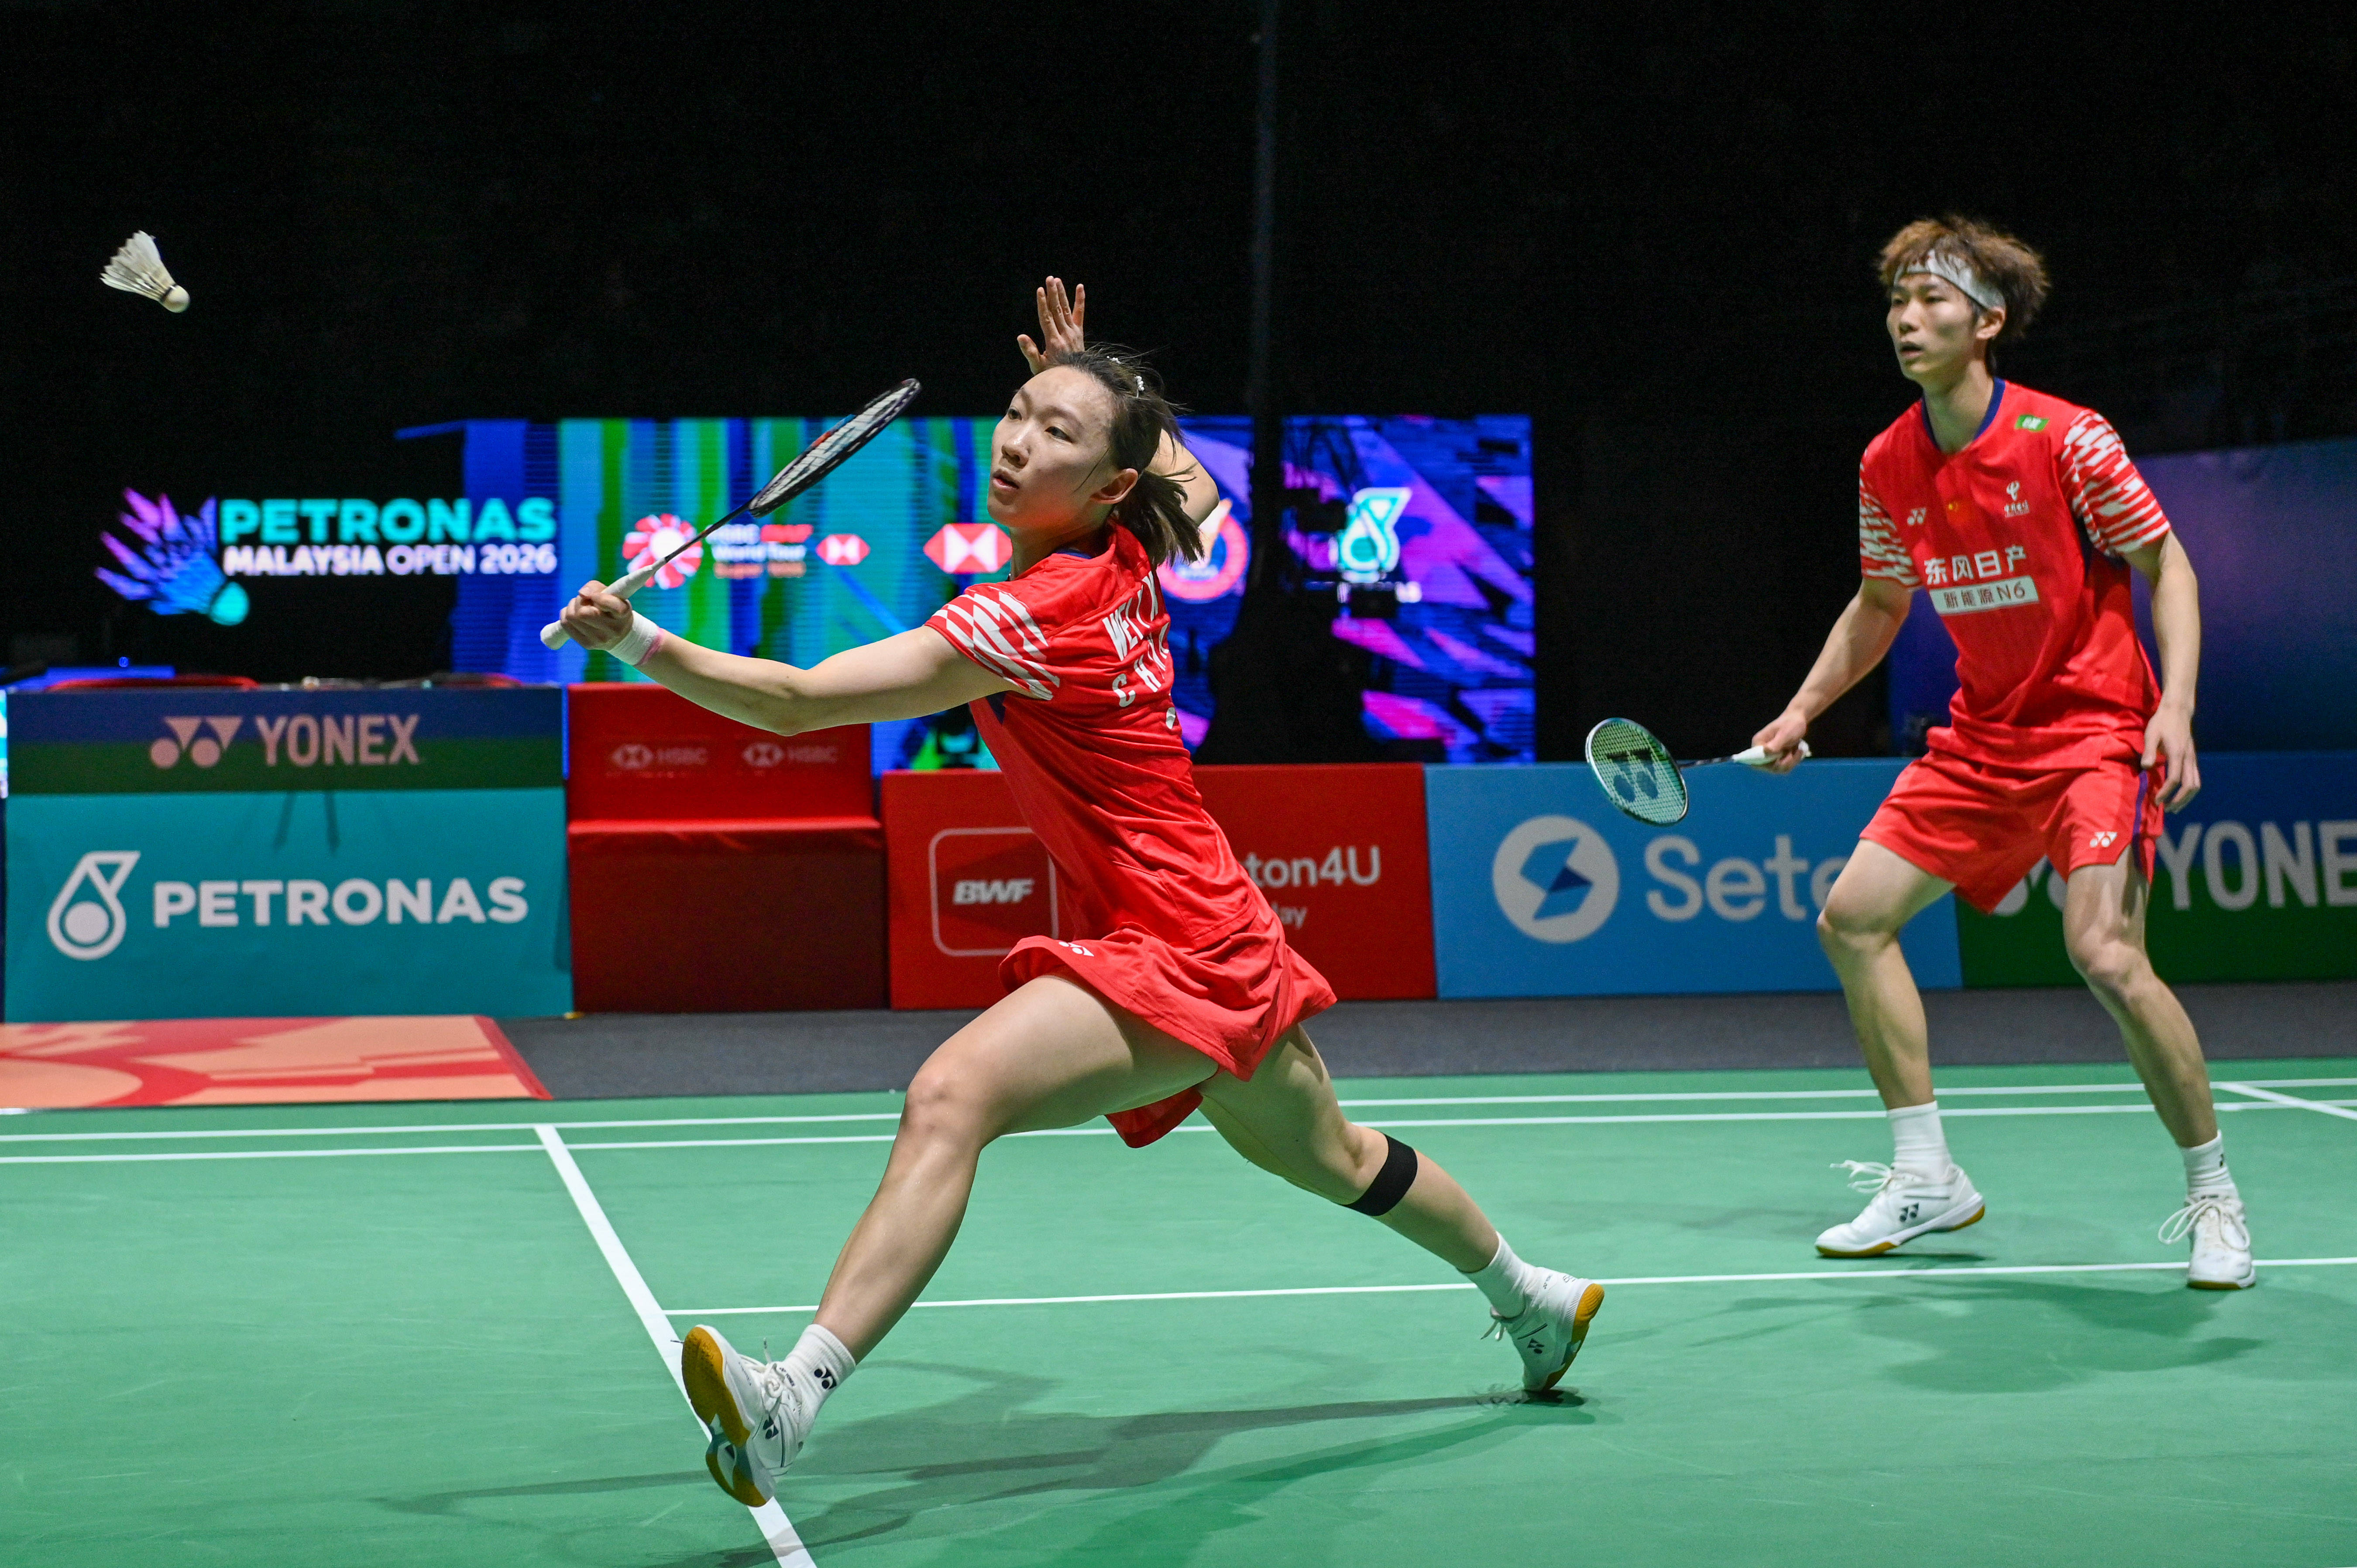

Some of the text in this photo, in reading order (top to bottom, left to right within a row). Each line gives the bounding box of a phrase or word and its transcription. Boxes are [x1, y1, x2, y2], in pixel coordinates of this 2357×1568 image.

[220, 498, 557, 543] PETRONAS
[223, 543, 557, 575] MALAYSIA OPEN 2026
[1924, 545, 2027, 585] 东风日产
[255, 714, 420, 766] YONEX
[1240, 846, 1381, 889] ton4U
[153, 876, 529, 927] PETRONAS
[953, 878, 1035, 905] BWF
